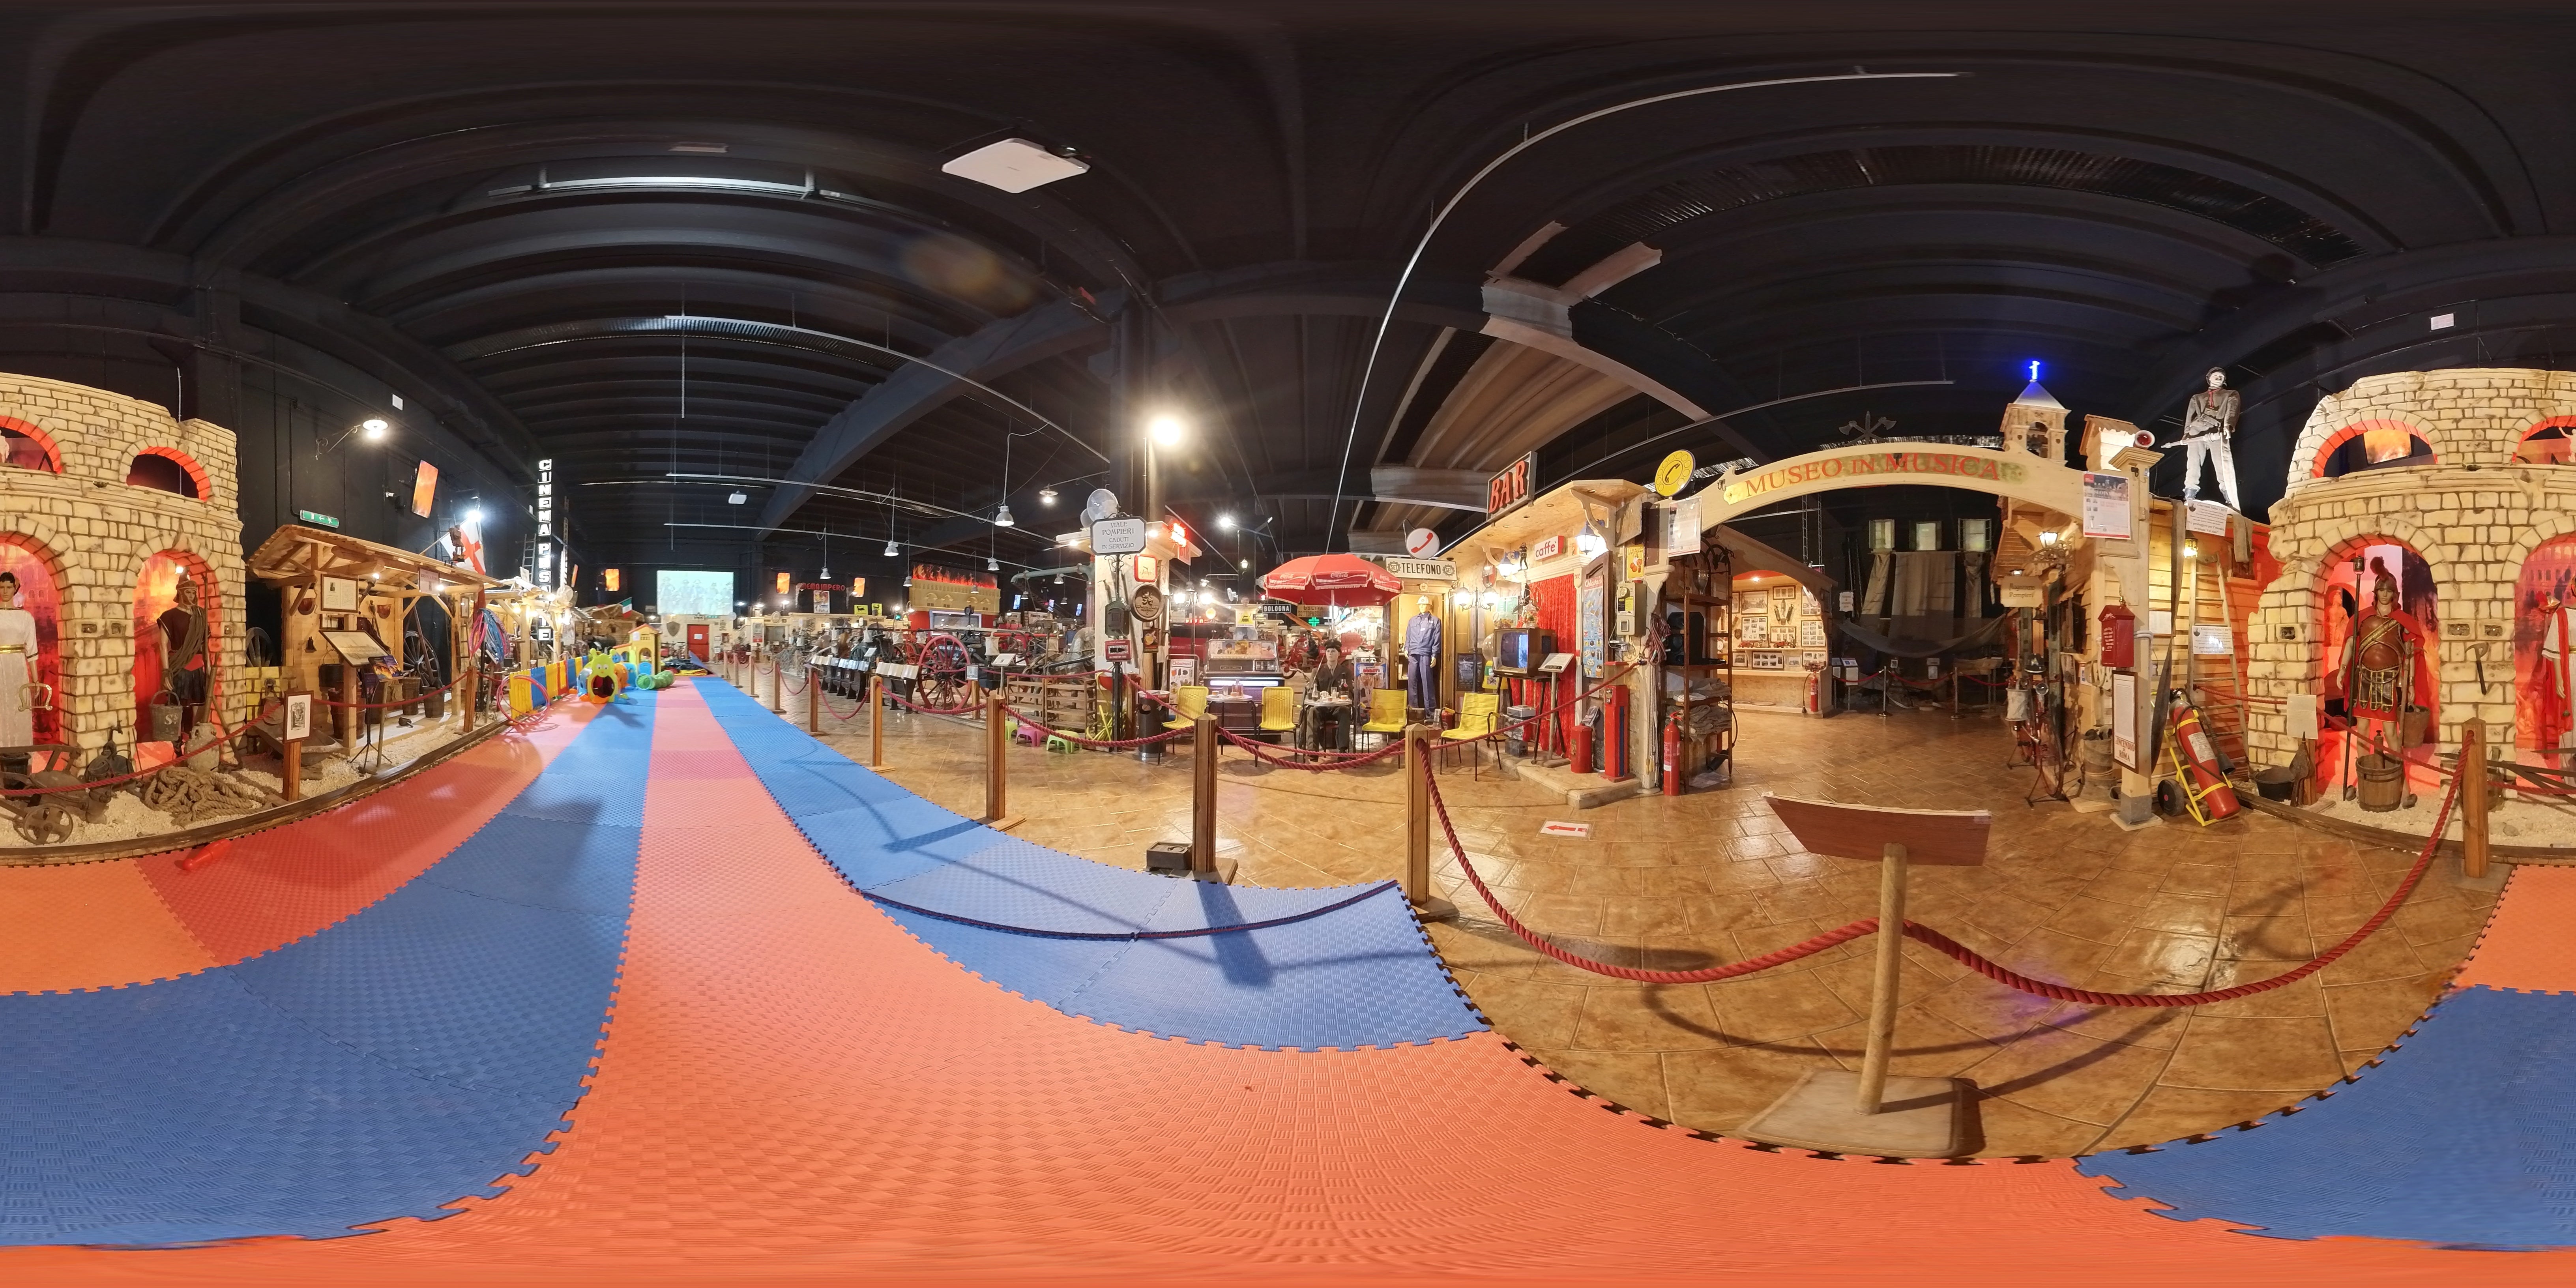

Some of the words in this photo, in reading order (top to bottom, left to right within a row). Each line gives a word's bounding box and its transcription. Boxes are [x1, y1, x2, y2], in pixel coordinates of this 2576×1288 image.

[538, 459, 552, 536] CINEMA
[1489, 461, 1526, 513] BAR
[1745, 459, 1842, 497] MUSEO
[1852, 458, 1875, 474] IN
[1885, 453, 1999, 480] MUSICA
[1402, 563, 1441, 575] TELEFONO
